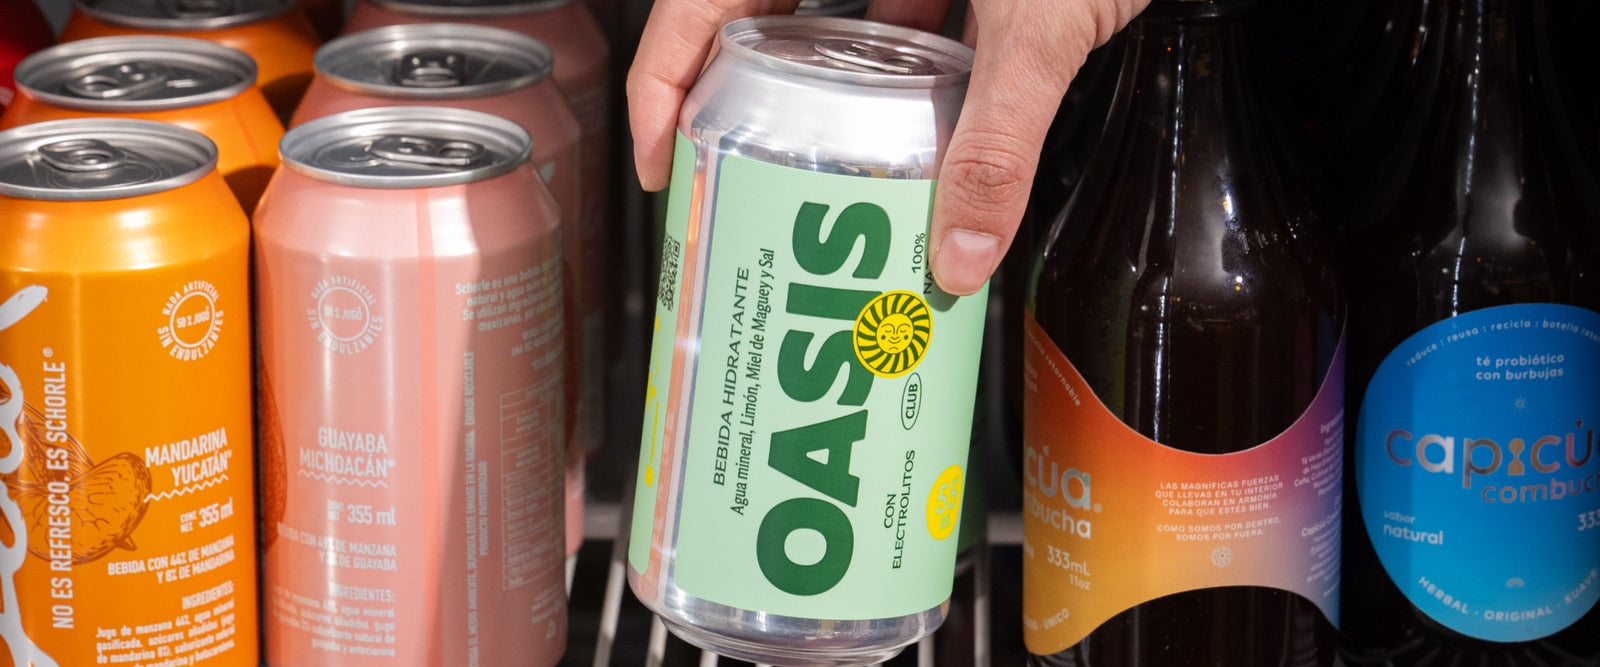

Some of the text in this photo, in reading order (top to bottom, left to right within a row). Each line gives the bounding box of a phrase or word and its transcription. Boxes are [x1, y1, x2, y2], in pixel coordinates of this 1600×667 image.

[911, 232, 926, 274] 100%
[162, 280, 220, 315] NADA ARTIFICIAL
[331, 275, 377, 306] ARTIFICIAL
[455, 279, 491, 296] Schorle
[157, 310, 224, 362] SIN ENDULZANTES
[318, 315, 384, 355] ENDULZANTES
[1406, 319, 1579, 367] reduce reusa recicla botella
[1475, 367, 1564, 381] con burbujas
[1476, 353, 1565, 370] té probiótico
[713, 266, 750, 486] BEBIDA HIDRATANTE
[730, 247, 775, 516] Agua mineral, Limón, Miel de Maguey y Sal
[756, 201, 892, 596] OASIS
[905, 382, 918, 420] CLUB
[145, 427, 228, 468] MANDARINA
[317, 427, 388, 454] GUAYABA
[46, 448, 69, 471] ES
[1154, 481, 1284, 499] QUE LLEVAS EN TU INTERIOR
[1160, 474, 1280, 490] LAS MAGNÍFICAS FUERZAS
[198, 496, 234, 528] 355 ml
[883, 494, 896, 529] CON
[892, 450, 916, 570] ELECTROLITOS
[1162, 491, 1278, 508] COLABORAN EN ARMONÍA
[1168, 507, 1193, 516] PARA
[1196, 507, 1216, 517] QUE
[1218, 504, 1247, 514] ESTÉS
[347, 503, 373, 526] 355
[376, 505, 396, 526] ml
[1156, 524, 1186, 533] COMO
[1188, 523, 1223, 533] SOMOS
[1225, 521, 1244, 531] POR
[1384, 510, 1416, 524] sabor
[1175, 528, 1265, 541] SOMOS POR FUERA.
[1383, 523, 1444, 545] natural
[107, 534, 235, 576] BEBIDA CON 44% DE MANZANA
[349, 541, 397, 558] MANZANA
[1046, 544, 1092, 577] 333mL
[156, 570, 164, 585] Y
[178, 564, 192, 580] DE
[191, 549, 236, 576] MANDARINA
[352, 555, 398, 572] GUAYABA
[51, 577, 73, 599] ES
[1069, 573, 1092, 591] 11oz
[1418, 567, 1599, 622] HERBAL ORIGINAL SUAVE
[53, 604, 74, 629] NO
[96, 626, 117, 640] Jugo
[120, 624, 132, 636] de
[135, 620, 173, 635] manzana
[109, 648, 156, 664] mandarina
